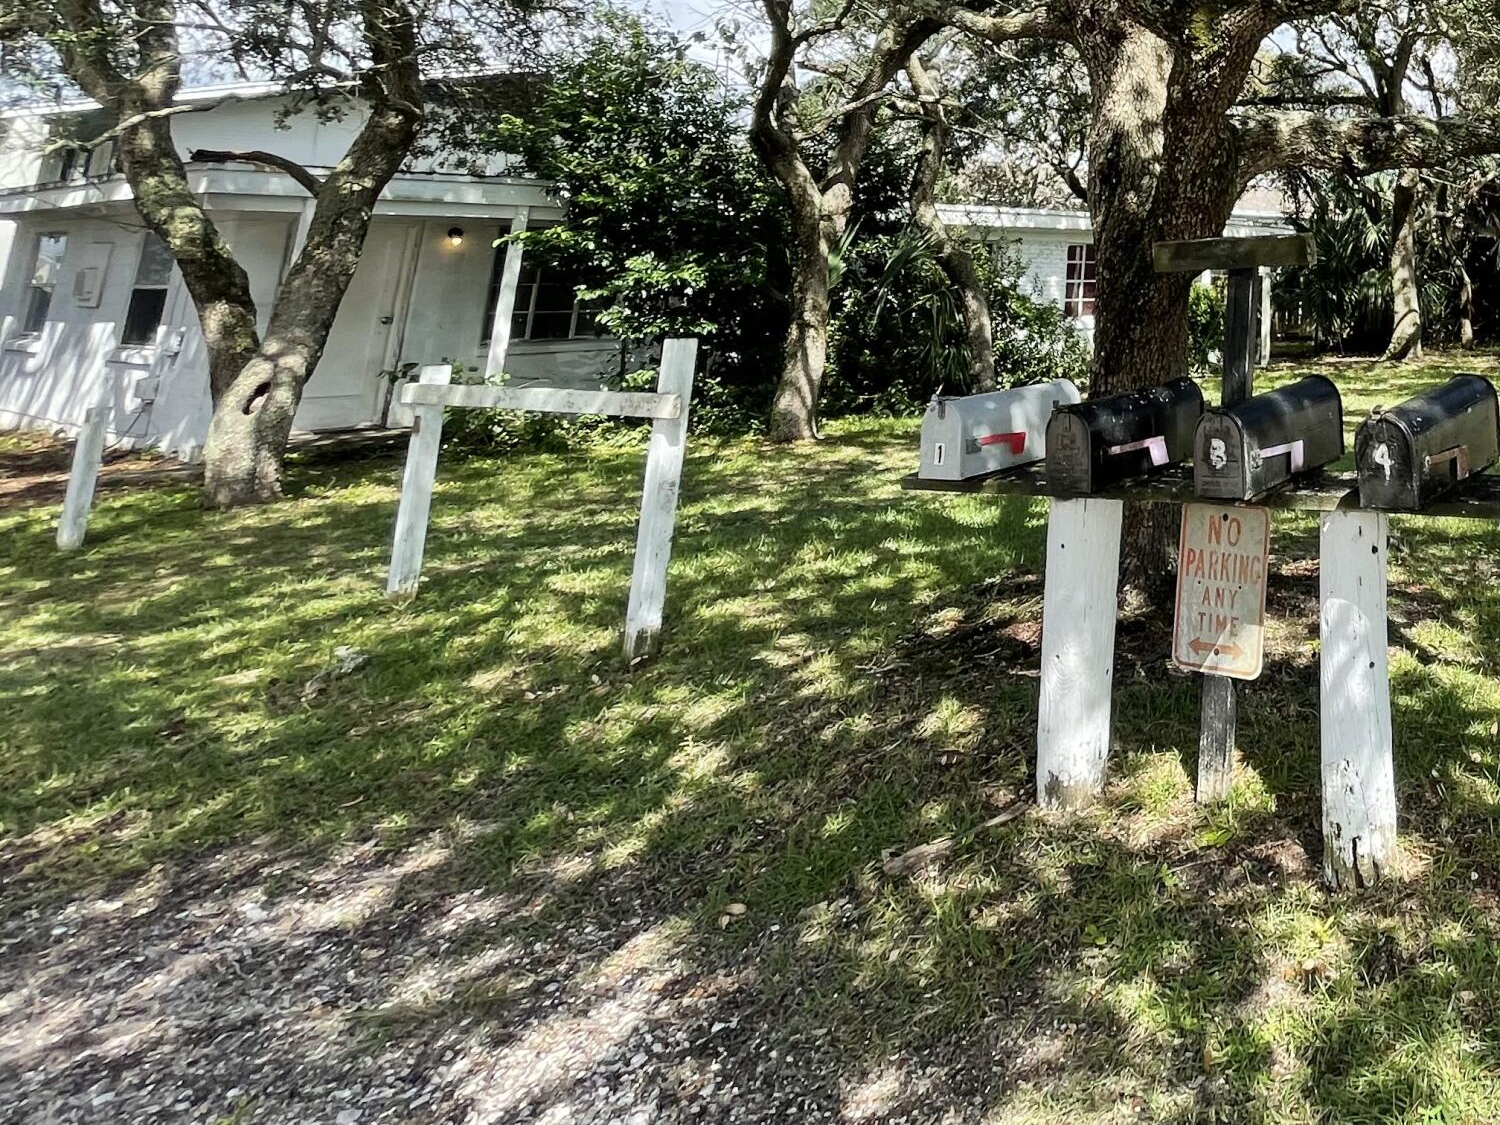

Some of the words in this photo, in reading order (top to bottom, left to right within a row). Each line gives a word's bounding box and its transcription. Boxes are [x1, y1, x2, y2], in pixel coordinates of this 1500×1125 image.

[1373, 443, 1395, 481] 4
[1208, 514, 1242, 547] NO
[1185, 547, 1262, 585] PARKING
[1202, 586, 1238, 610] ANY
[1198, 612, 1239, 637] TIME
